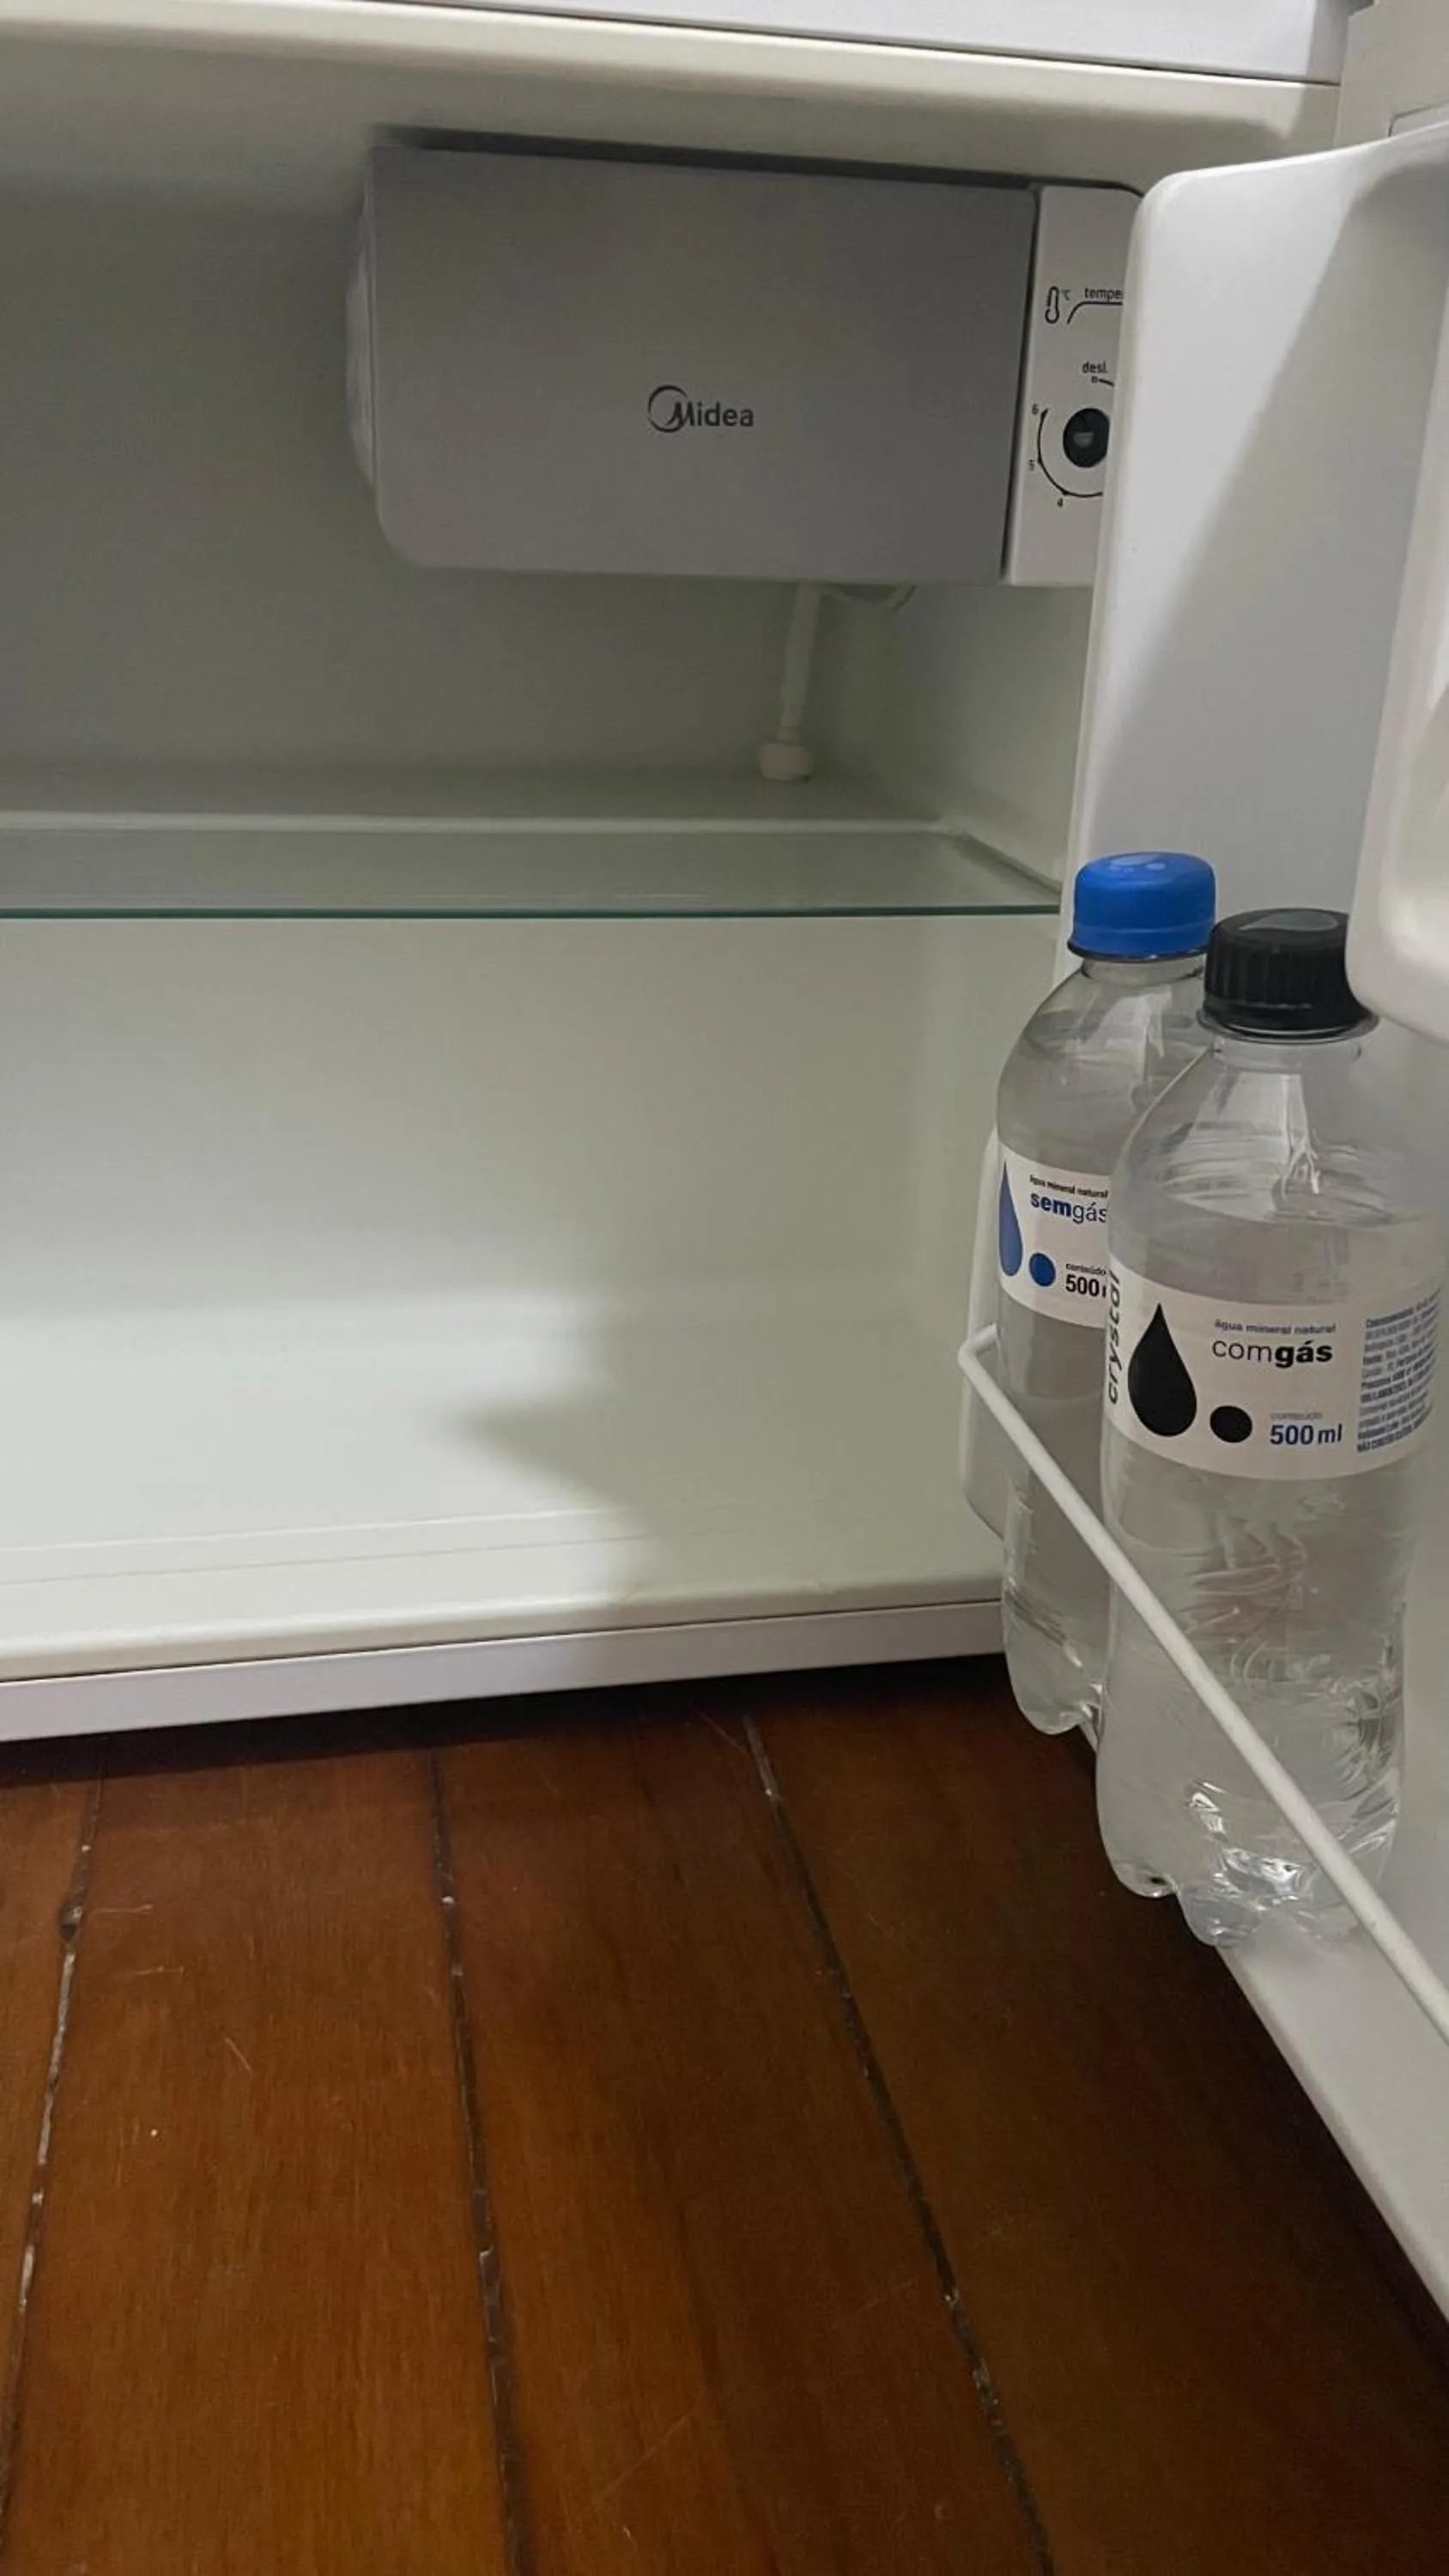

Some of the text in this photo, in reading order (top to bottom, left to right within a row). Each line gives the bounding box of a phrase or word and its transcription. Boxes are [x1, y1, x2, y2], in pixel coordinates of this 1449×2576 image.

[647, 385, 755, 433] Midea
[1057, 497, 1064, 508] 4
[1246, 1324, 1292, 1334] mineral
[1294, 1322, 1337, 1334] natural
